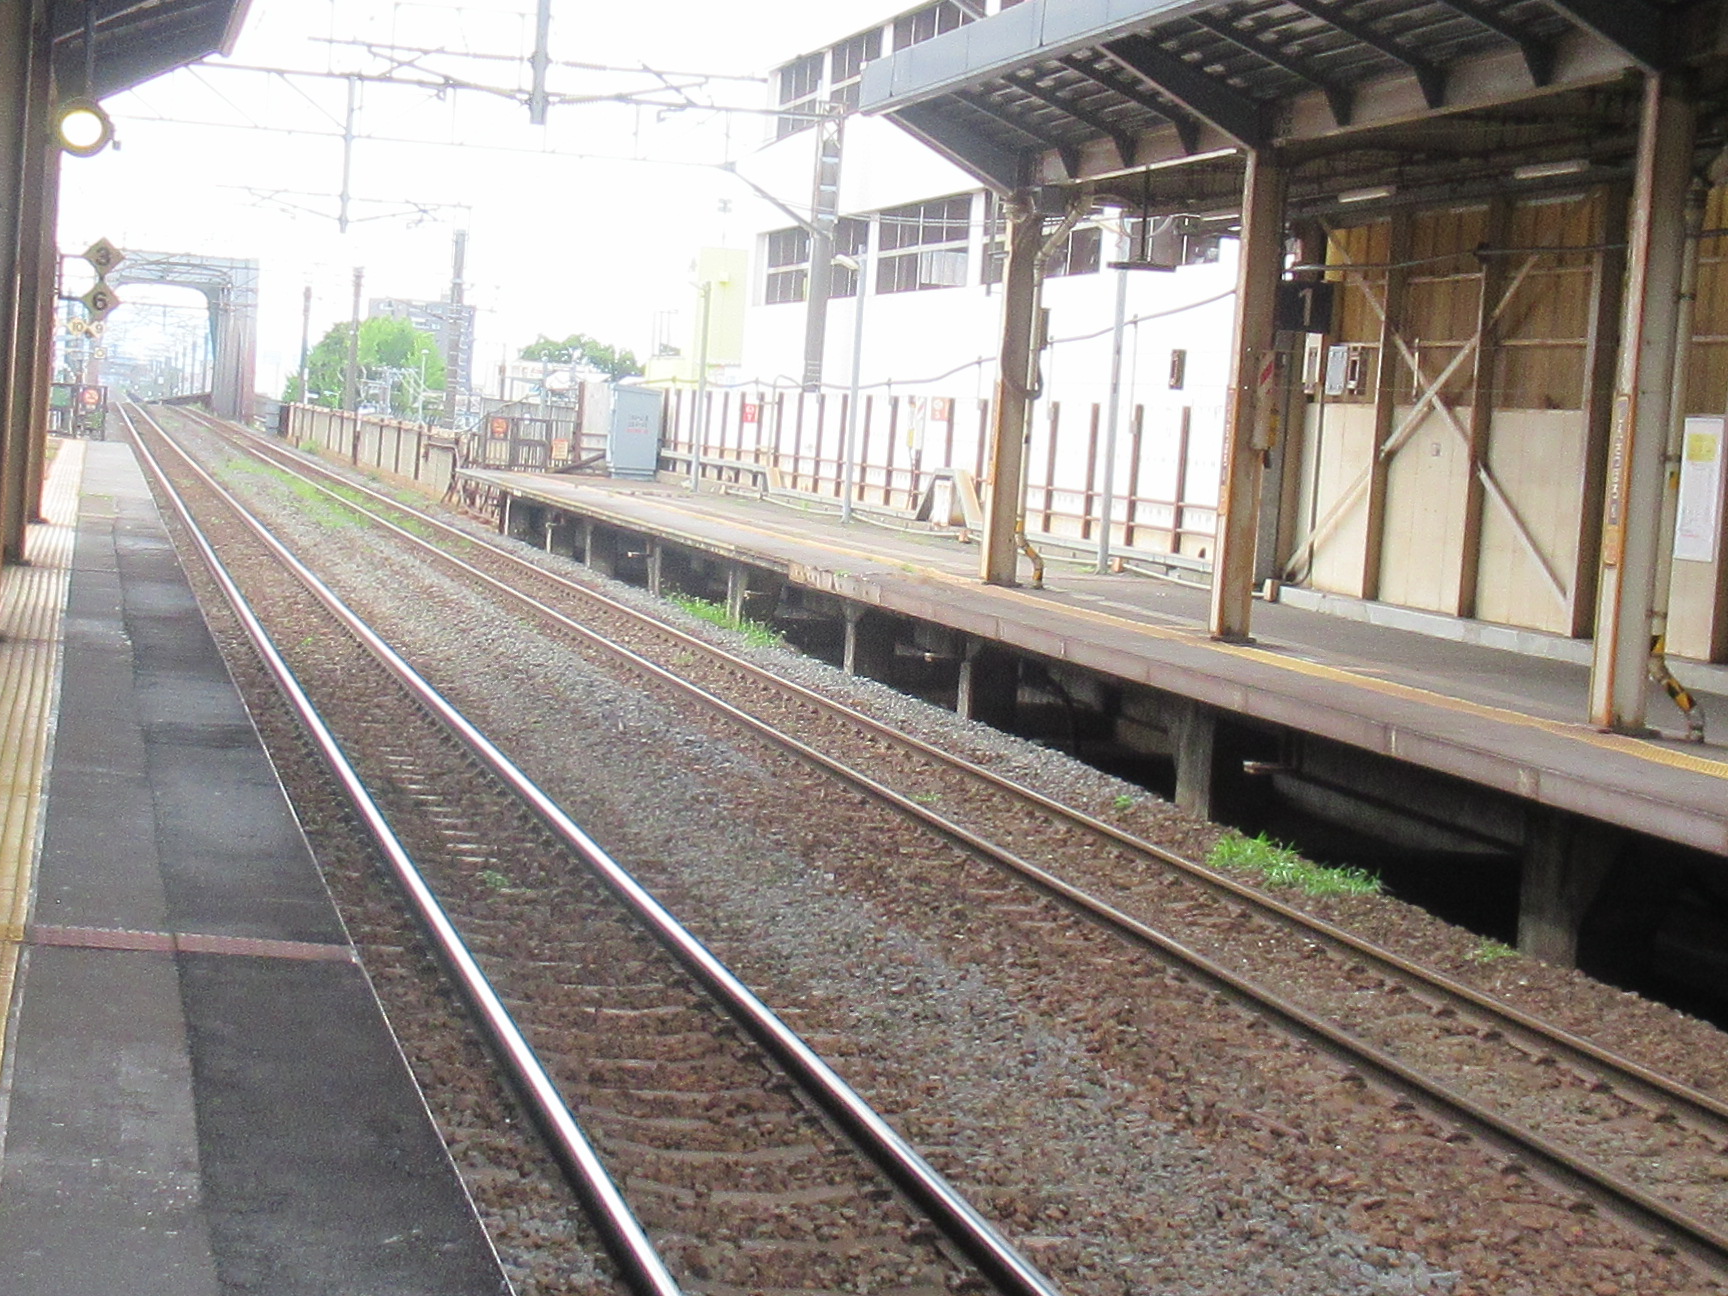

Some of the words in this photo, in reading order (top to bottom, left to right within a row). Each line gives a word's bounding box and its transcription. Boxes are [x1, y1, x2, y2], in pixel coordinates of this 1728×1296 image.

[95, 246, 111, 267] 3
[92, 291, 109, 312] 6
[1298, 287, 1314, 327] 1
